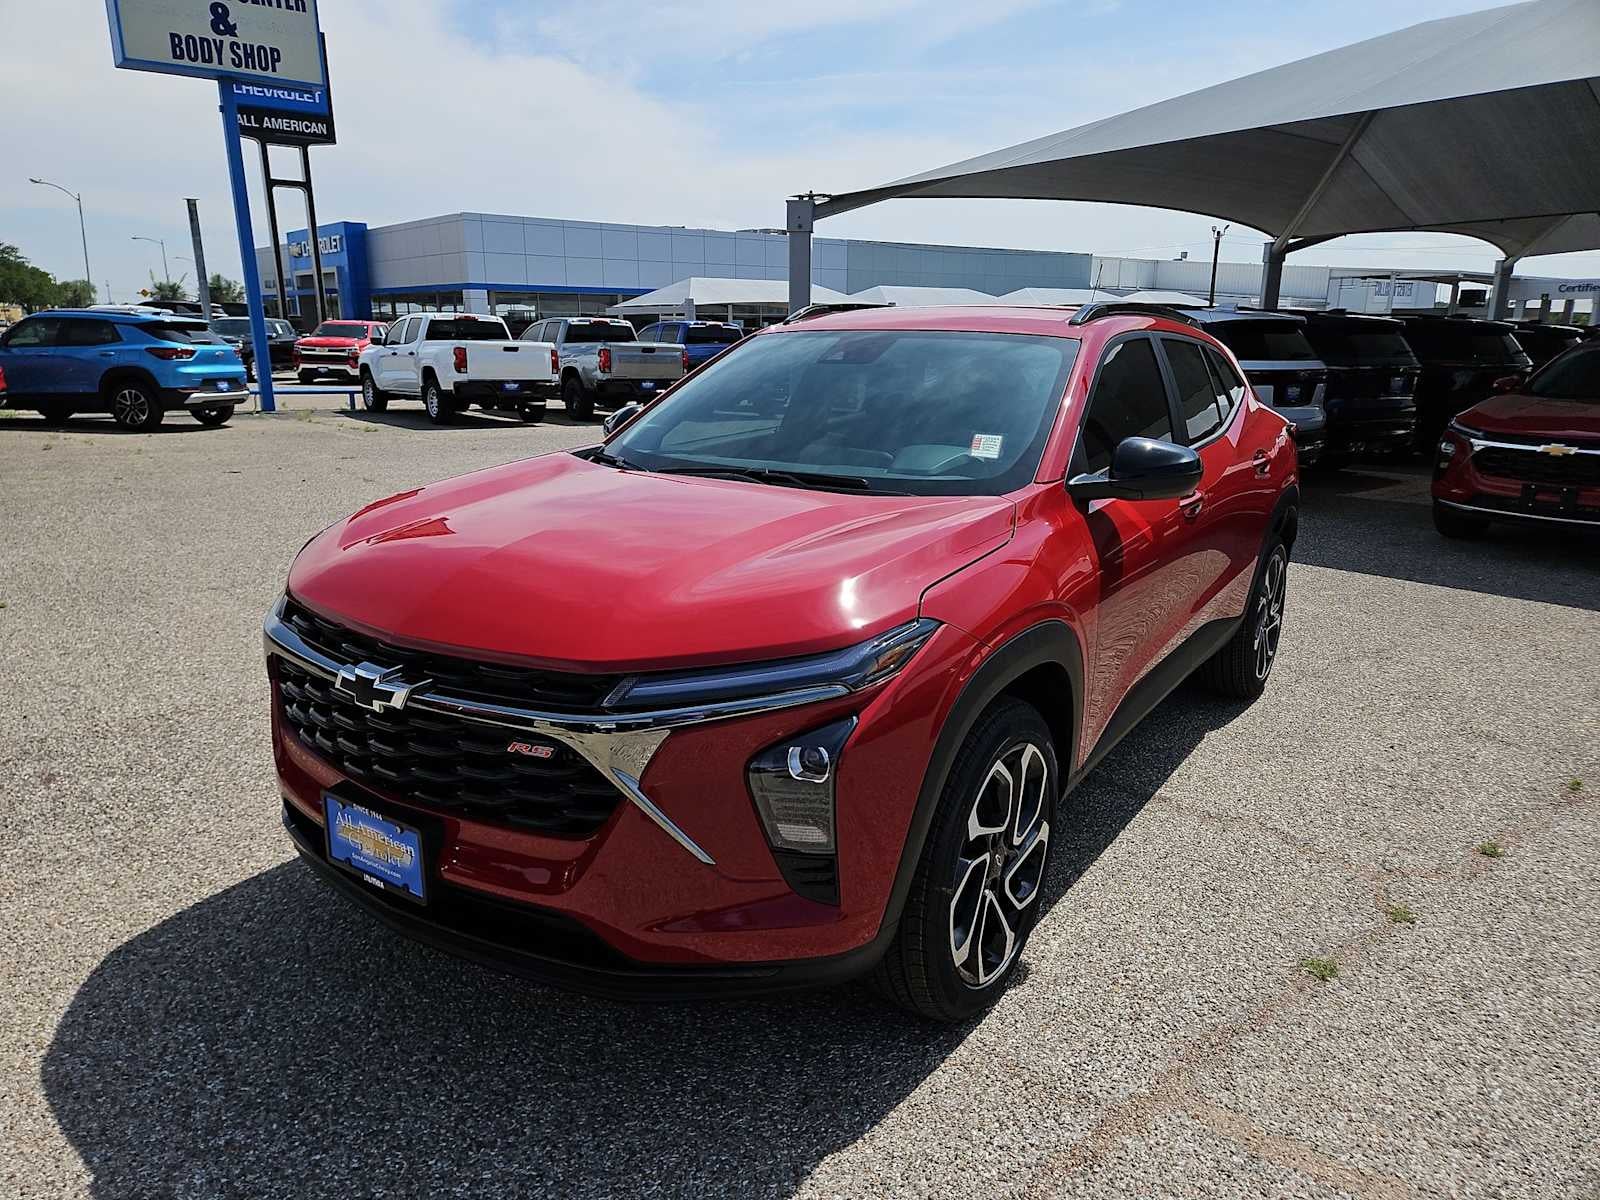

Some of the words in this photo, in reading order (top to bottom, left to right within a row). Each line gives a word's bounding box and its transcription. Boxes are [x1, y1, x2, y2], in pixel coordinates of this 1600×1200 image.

[209, 1, 238, 37] &
[169, 32, 224, 66] BODY
[230, 40, 281, 73] SHOP
[262, 116, 327, 135] AMERICAN
[507, 741, 554, 758] RS
[336, 811, 353, 829] All
